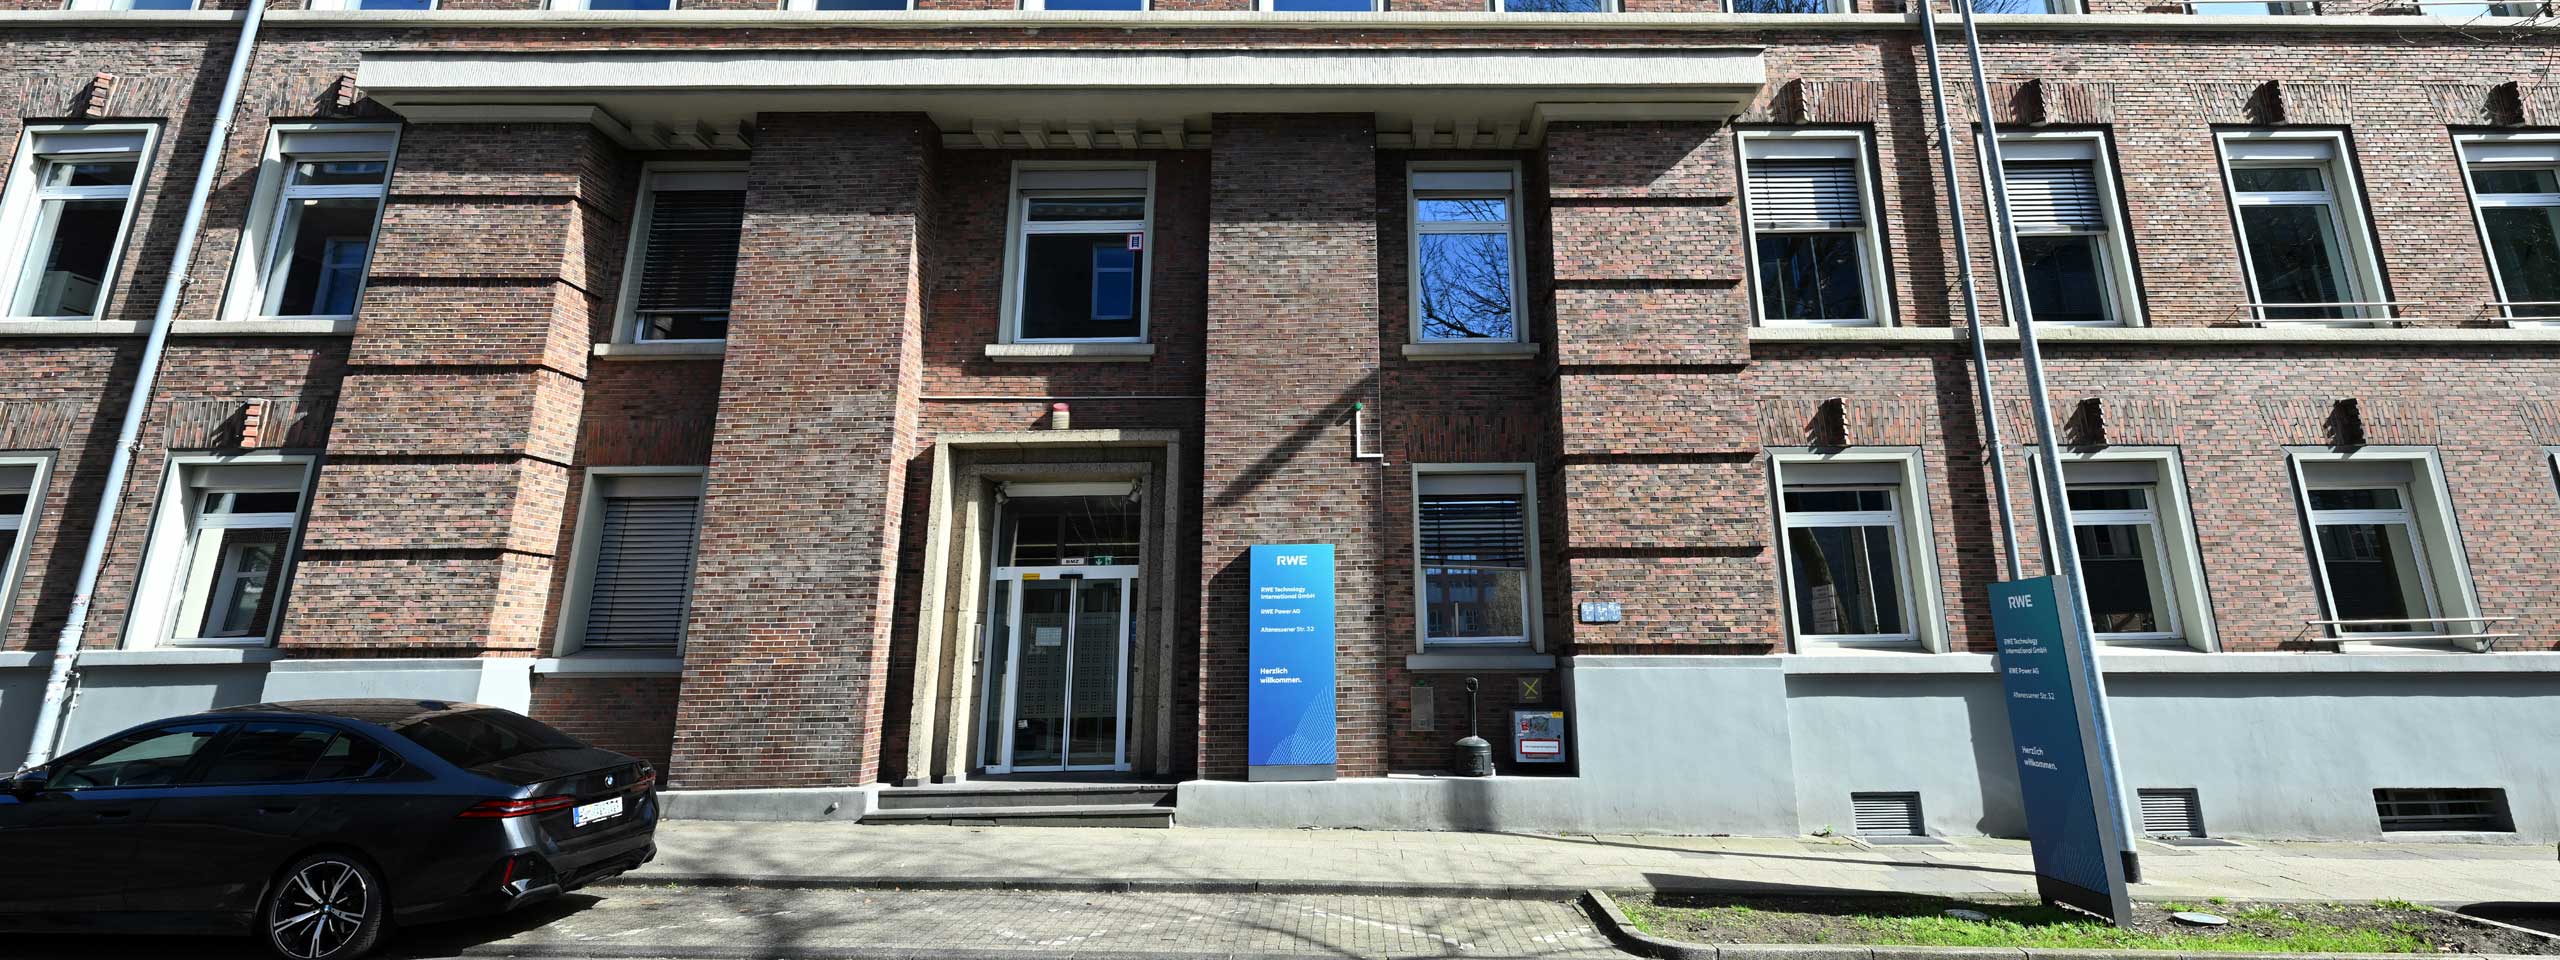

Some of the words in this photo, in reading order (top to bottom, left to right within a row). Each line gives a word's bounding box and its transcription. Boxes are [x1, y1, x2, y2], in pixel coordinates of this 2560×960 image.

[1276, 555, 1308, 566] RWE
[2008, 594, 2033, 609] RWE
[2013, 637, 2038, 646] Technology
[2005, 646, 2033, 654] International
[2032, 646, 2048, 654] GmbH
[1260, 667, 1289, 675] Herzlich
[2018, 667, 2032, 675] Power
[2032, 667, 2040, 675] AG
[1260, 676, 1303, 684] willkommen.
[2039, 692, 2048, 700] Str.
[2047, 692, 2055, 700] 32
[2021, 745, 2044, 756] Herzlich
[2023, 757, 2058, 771] willkommen.
